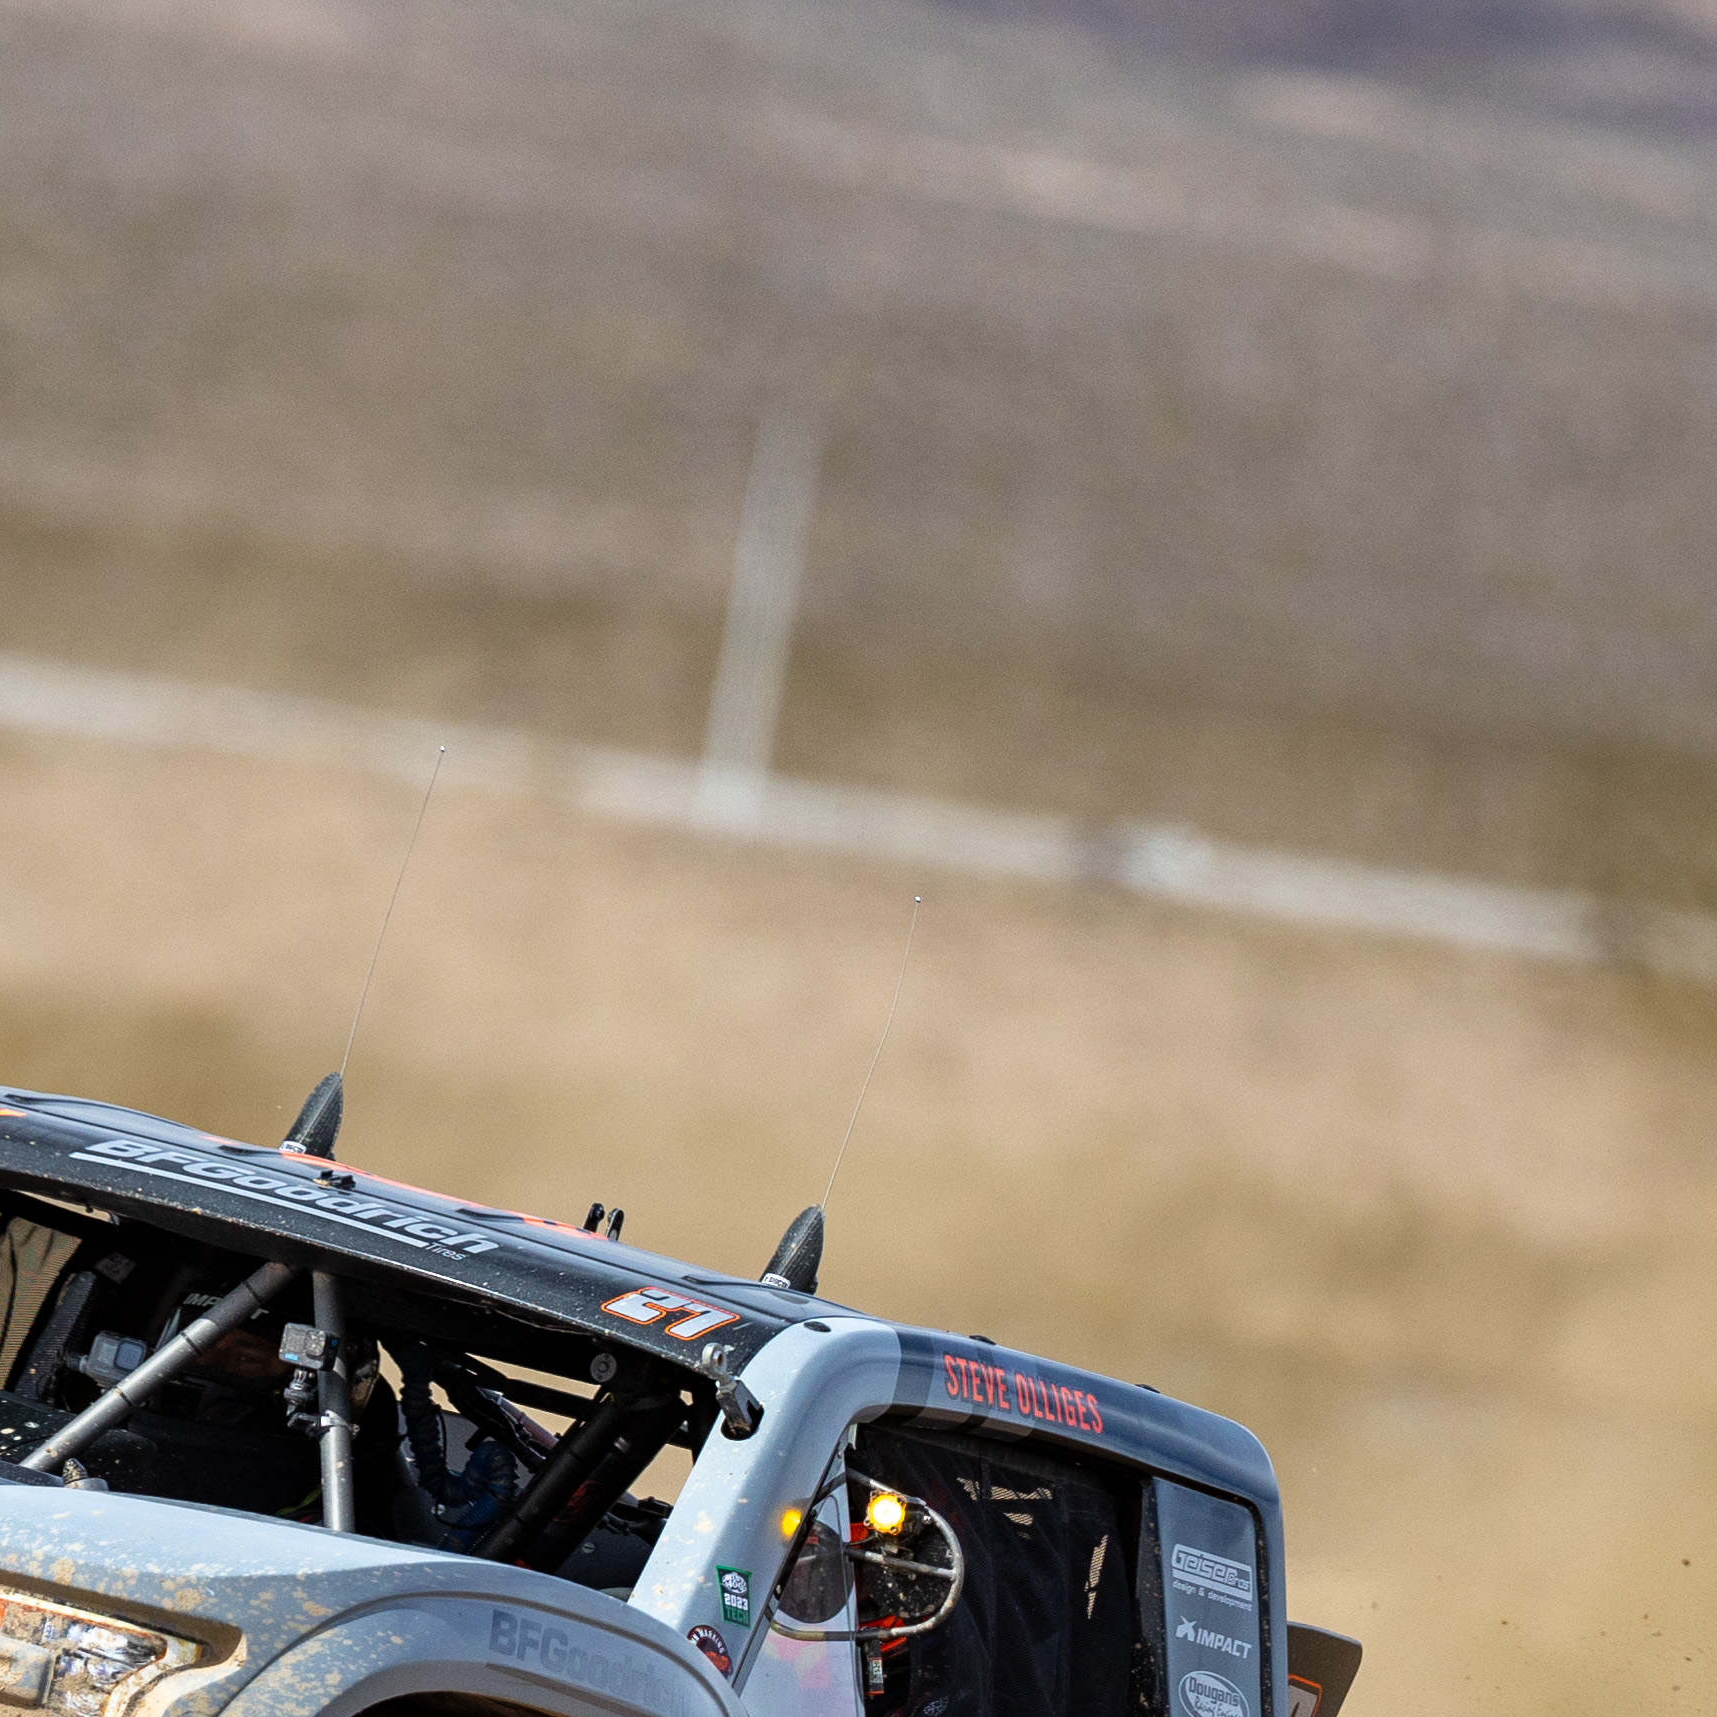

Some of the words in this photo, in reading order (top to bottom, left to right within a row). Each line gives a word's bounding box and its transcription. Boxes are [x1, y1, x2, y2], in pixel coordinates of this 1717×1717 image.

[85, 1139, 500, 1254] BFGoodrich
[425, 1241, 466, 1261] Tires
[183, 1293, 270, 1320] IMPT
[944, 1354, 1010, 1410] STEVE
[1014, 1373, 1103, 1434] OLLIGES
[724, 1592, 749, 1611] 2023
[1196, 1628, 1253, 1659] IMPACT
[1188, 1677, 1240, 1707] Dougans
